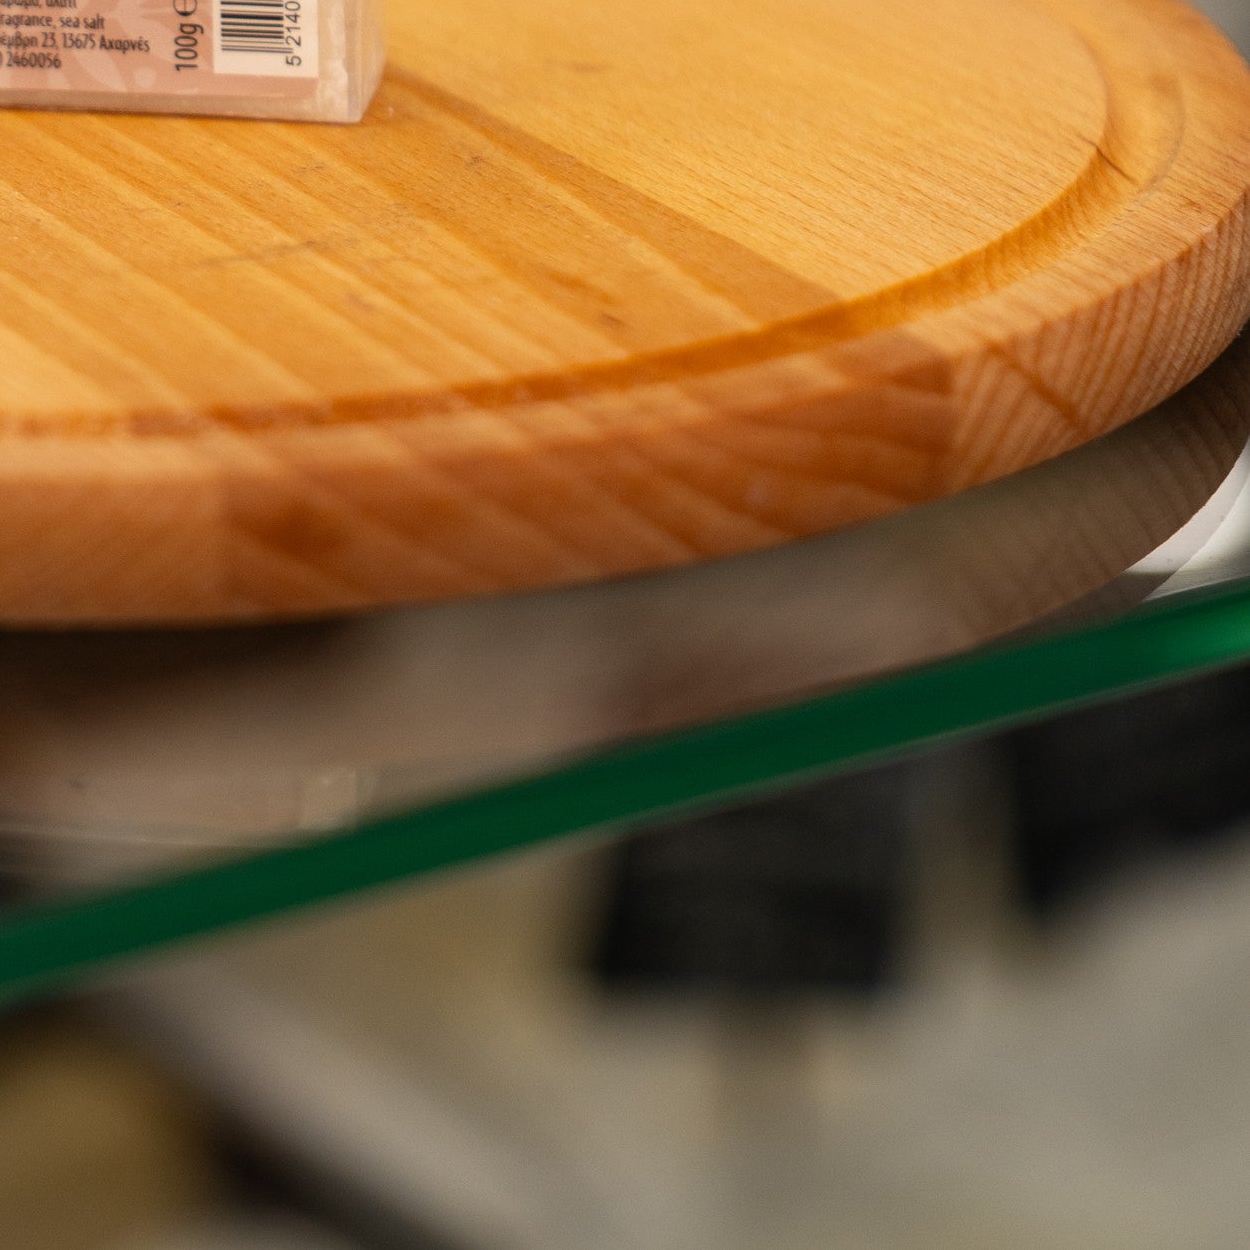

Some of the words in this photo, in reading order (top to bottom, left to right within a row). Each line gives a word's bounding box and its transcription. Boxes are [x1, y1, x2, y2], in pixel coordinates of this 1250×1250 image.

[59, 15, 80, 29] sea
[83, 13, 105, 30] salt
[62, 32, 96, 50] 13675
[99, 34, 150, 54] Αχαρνές
[175, 22, 204, 71] 100g
[6, 51, 62, 69] 2460056
